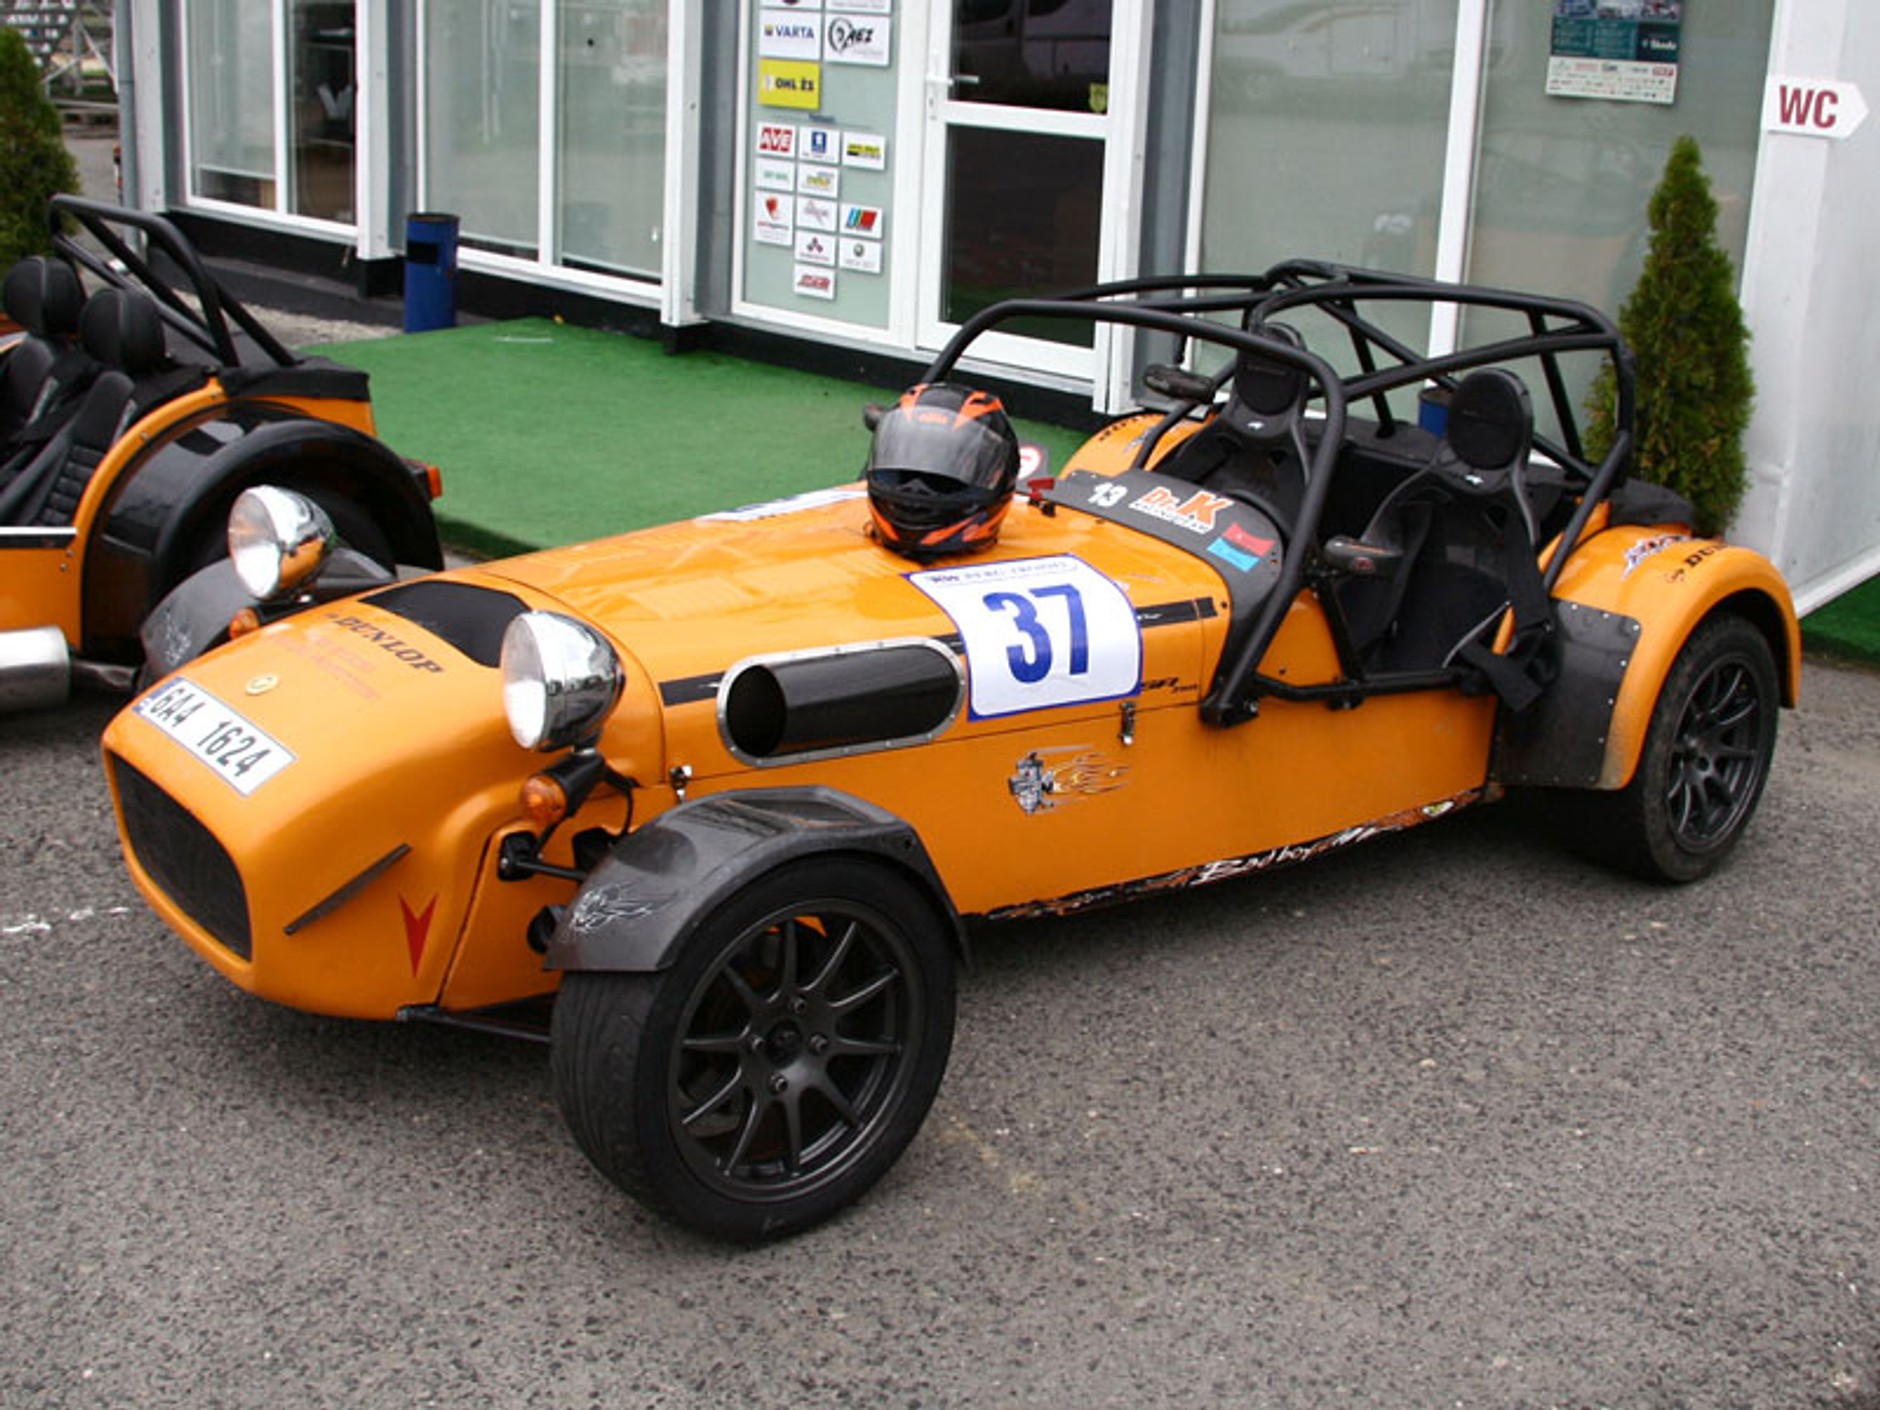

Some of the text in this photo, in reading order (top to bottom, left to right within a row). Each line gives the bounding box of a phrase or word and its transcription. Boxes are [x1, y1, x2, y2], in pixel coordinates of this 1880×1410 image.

[776, 25, 815, 39] VARTA
[1778, 85, 1839, 129] WC
[1088, 482, 1129, 508] 13
[334, 615, 444, 674] DUNLOP
[982, 583, 1089, 684] 37
[197, 720, 272, 777] 1624
